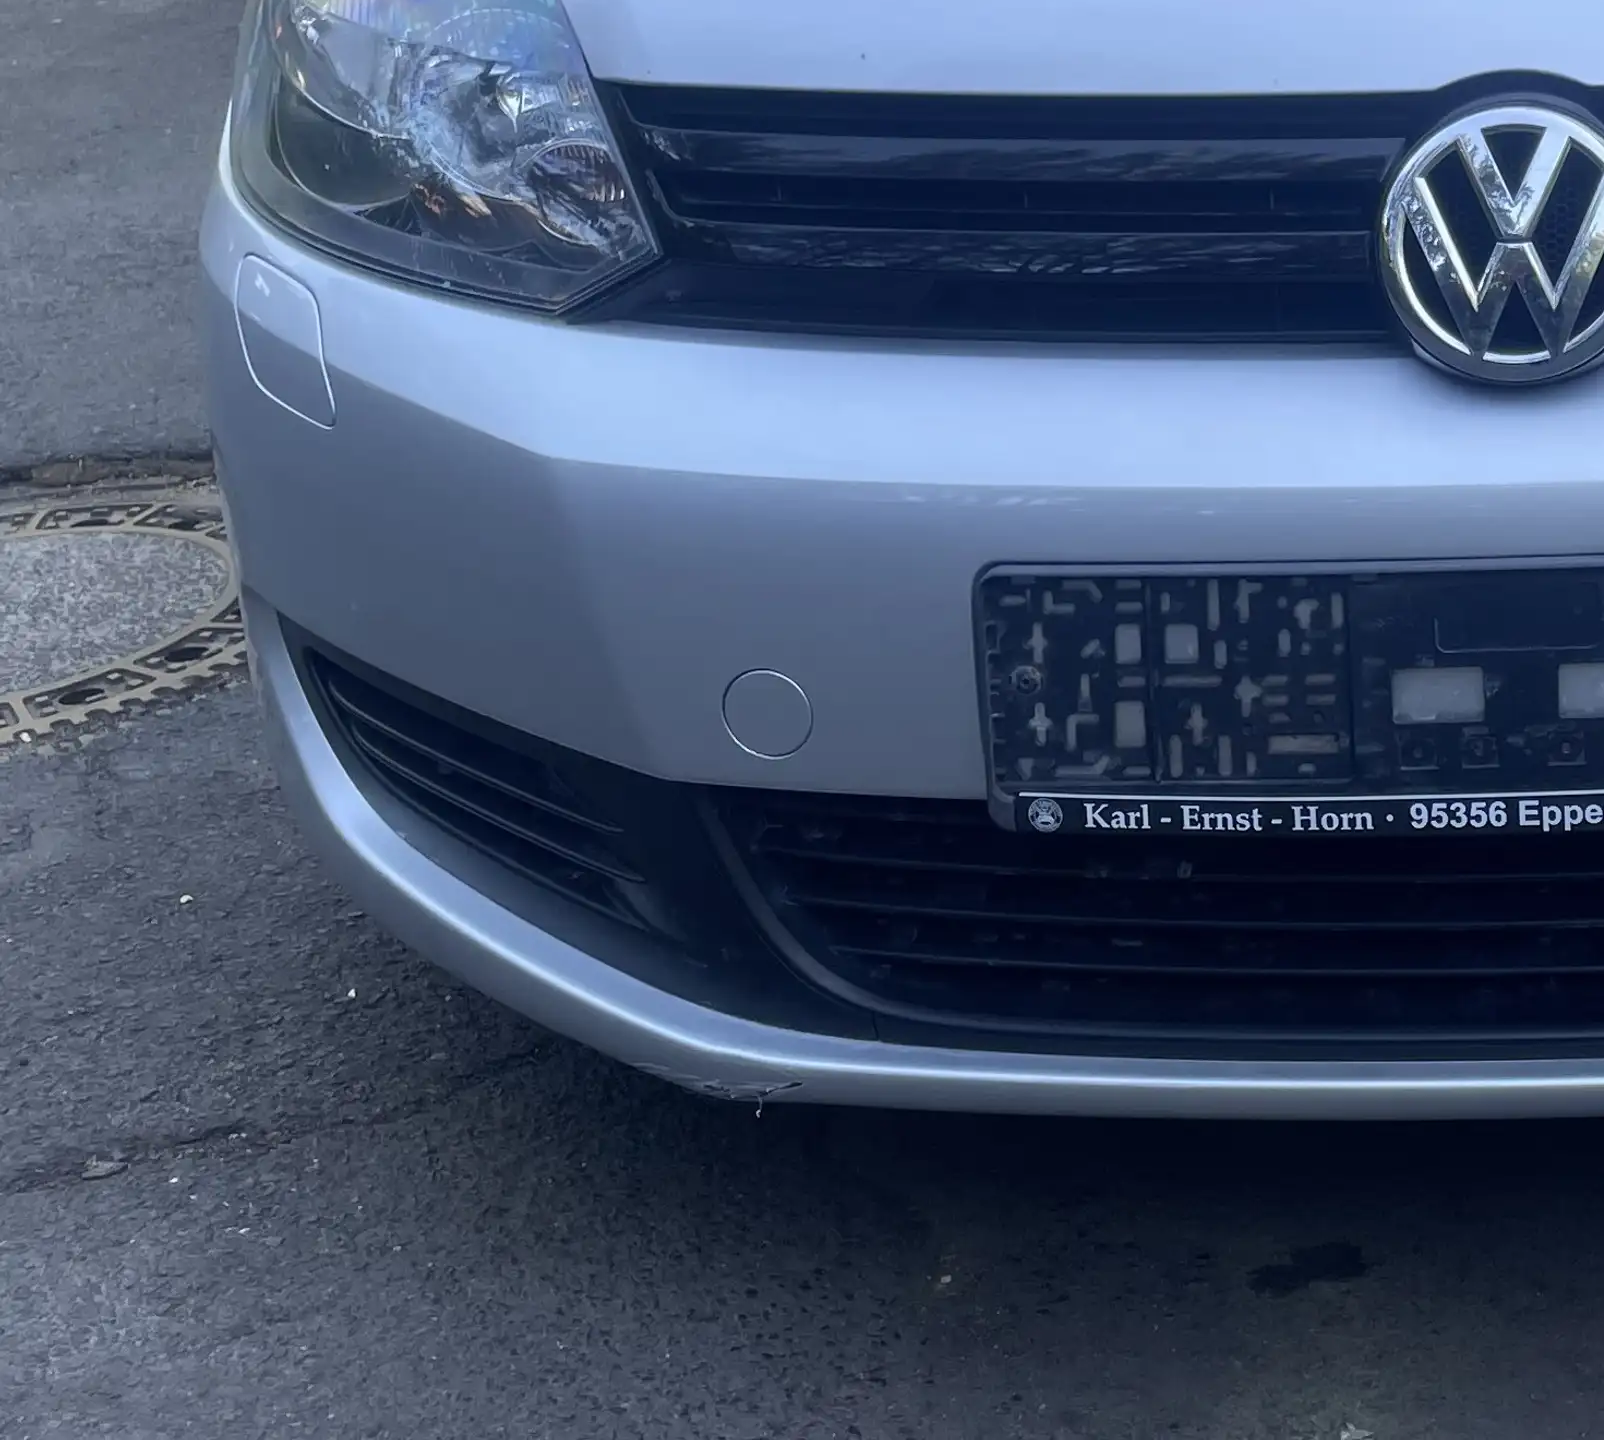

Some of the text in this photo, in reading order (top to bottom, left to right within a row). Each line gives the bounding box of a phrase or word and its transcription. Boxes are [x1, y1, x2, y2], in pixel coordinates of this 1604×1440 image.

[1083, 803, 1151, 830] Karl
[1180, 804, 1263, 832] Ernst
[1291, 805, 1375, 832] Horn
[1409, 801, 1508, 830] 95356
